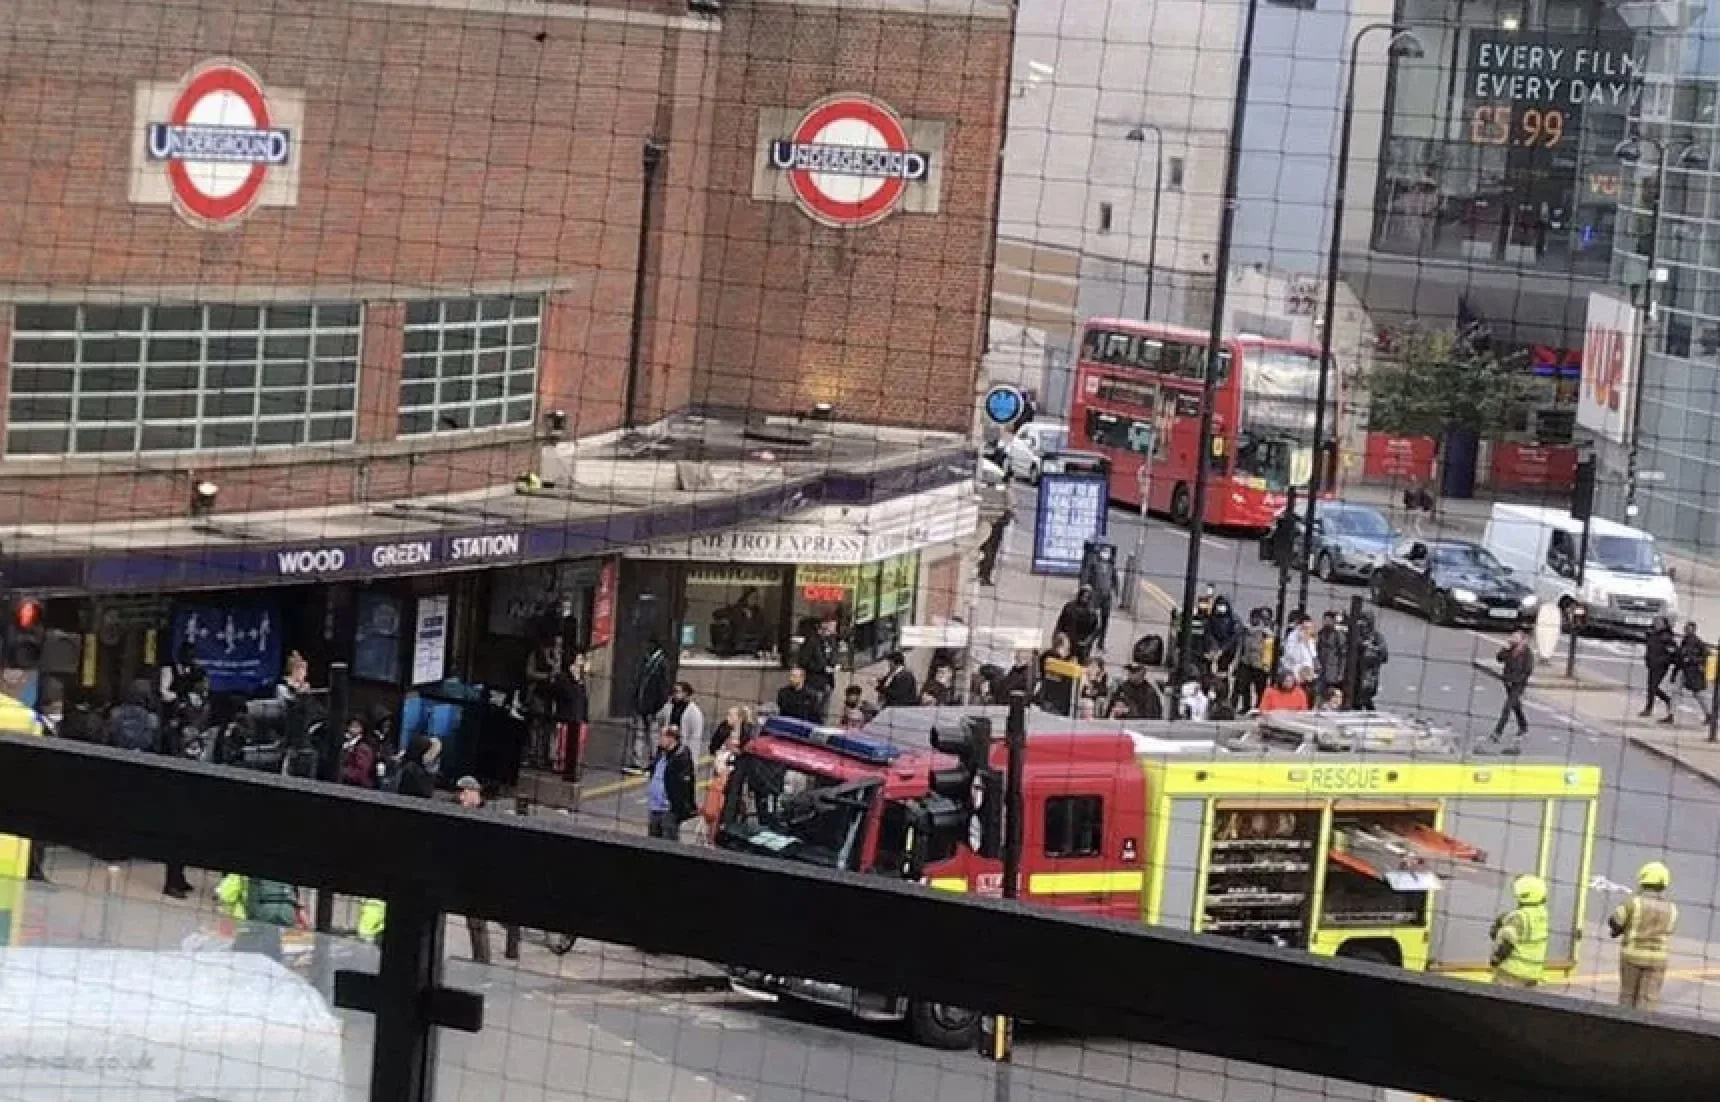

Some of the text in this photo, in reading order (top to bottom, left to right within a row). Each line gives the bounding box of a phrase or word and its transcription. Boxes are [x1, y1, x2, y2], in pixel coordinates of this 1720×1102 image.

[1478, 43, 1564, 71] EVERY
[1474, 73, 1625, 105] EVERY DAY
[151, 123, 288, 161] UNDERGROUND
[1470, 105, 1563, 148] £5.99
[773, 141, 924, 179] UNDERGROUND
[277, 534, 517, 574] WOOD GREEN STATION
[1312, 767, 1379, 789] RESCUE
